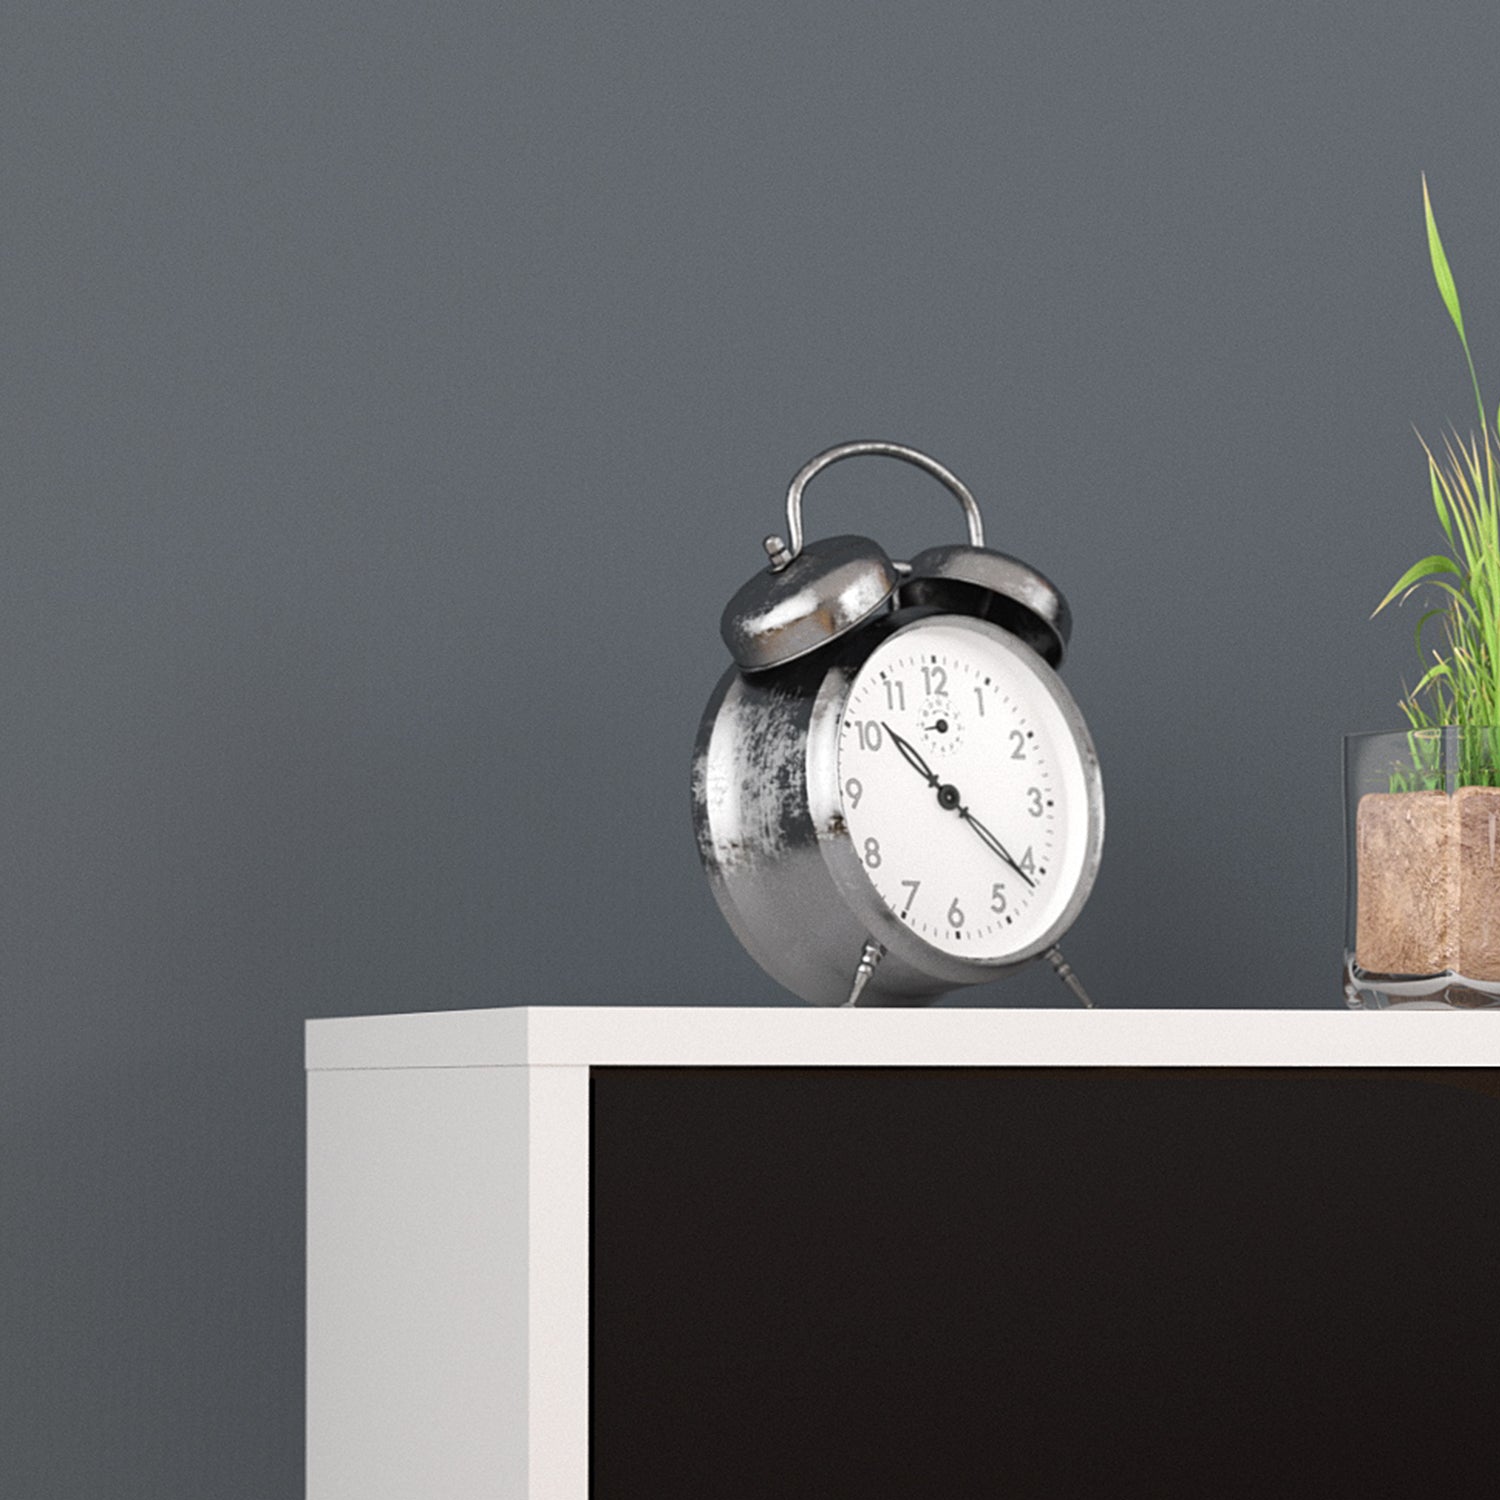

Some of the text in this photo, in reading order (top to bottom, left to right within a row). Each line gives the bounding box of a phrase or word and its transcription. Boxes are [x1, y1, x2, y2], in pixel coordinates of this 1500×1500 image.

[883, 680, 907, 711] 11
[921, 666, 949, 697] 12
[973, 686, 985, 717] 1
[855, 721, 883, 752] 10
[1009, 730, 1027, 760] 2
[845, 777, 863, 809] 9
[1026, 786, 1044, 817] 3
[864, 837, 882, 869] 8
[1019, 846, 1036, 875] 4
[900, 880, 921, 911] 7
[990, 884, 1007, 914] 5
[947, 897, 965, 928] 6
